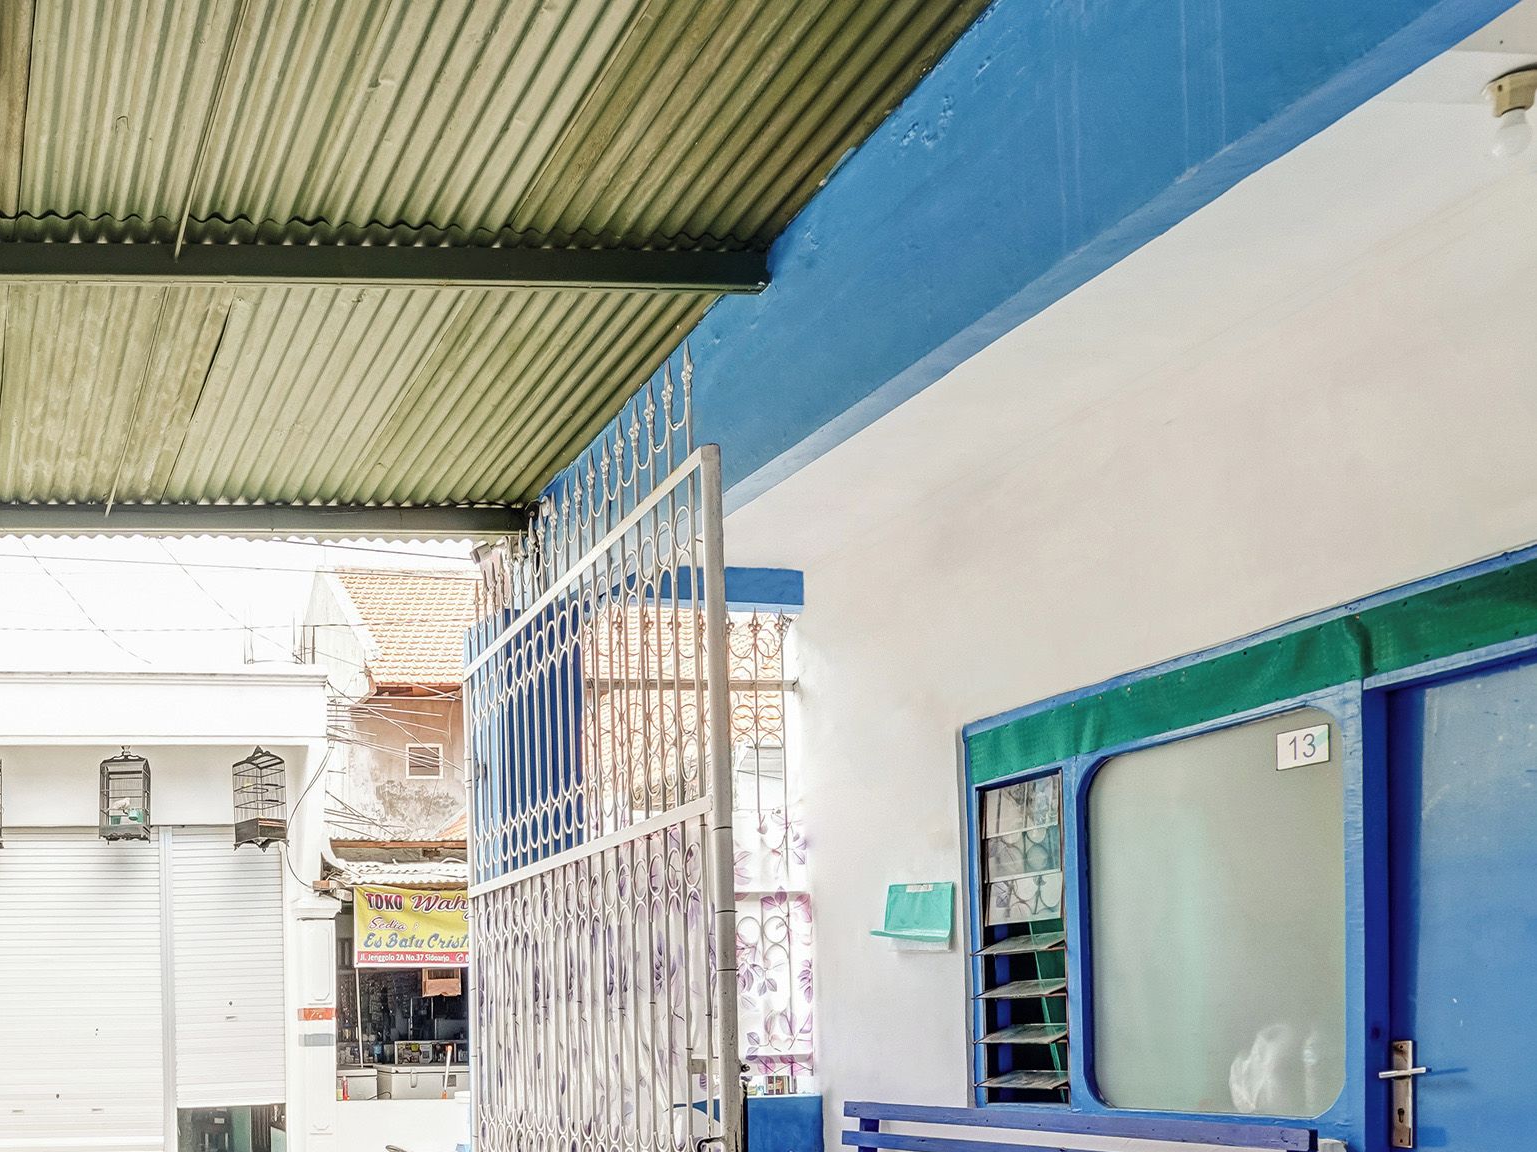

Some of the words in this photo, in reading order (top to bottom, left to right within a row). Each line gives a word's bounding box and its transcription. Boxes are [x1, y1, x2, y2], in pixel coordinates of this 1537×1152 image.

[1288, 733, 1316, 760] 13
[365, 892, 403, 911] TOKO
[368, 915, 408, 930] Sedia
[364, 932, 382, 948] Es
[386, 932, 425, 949] Batu
